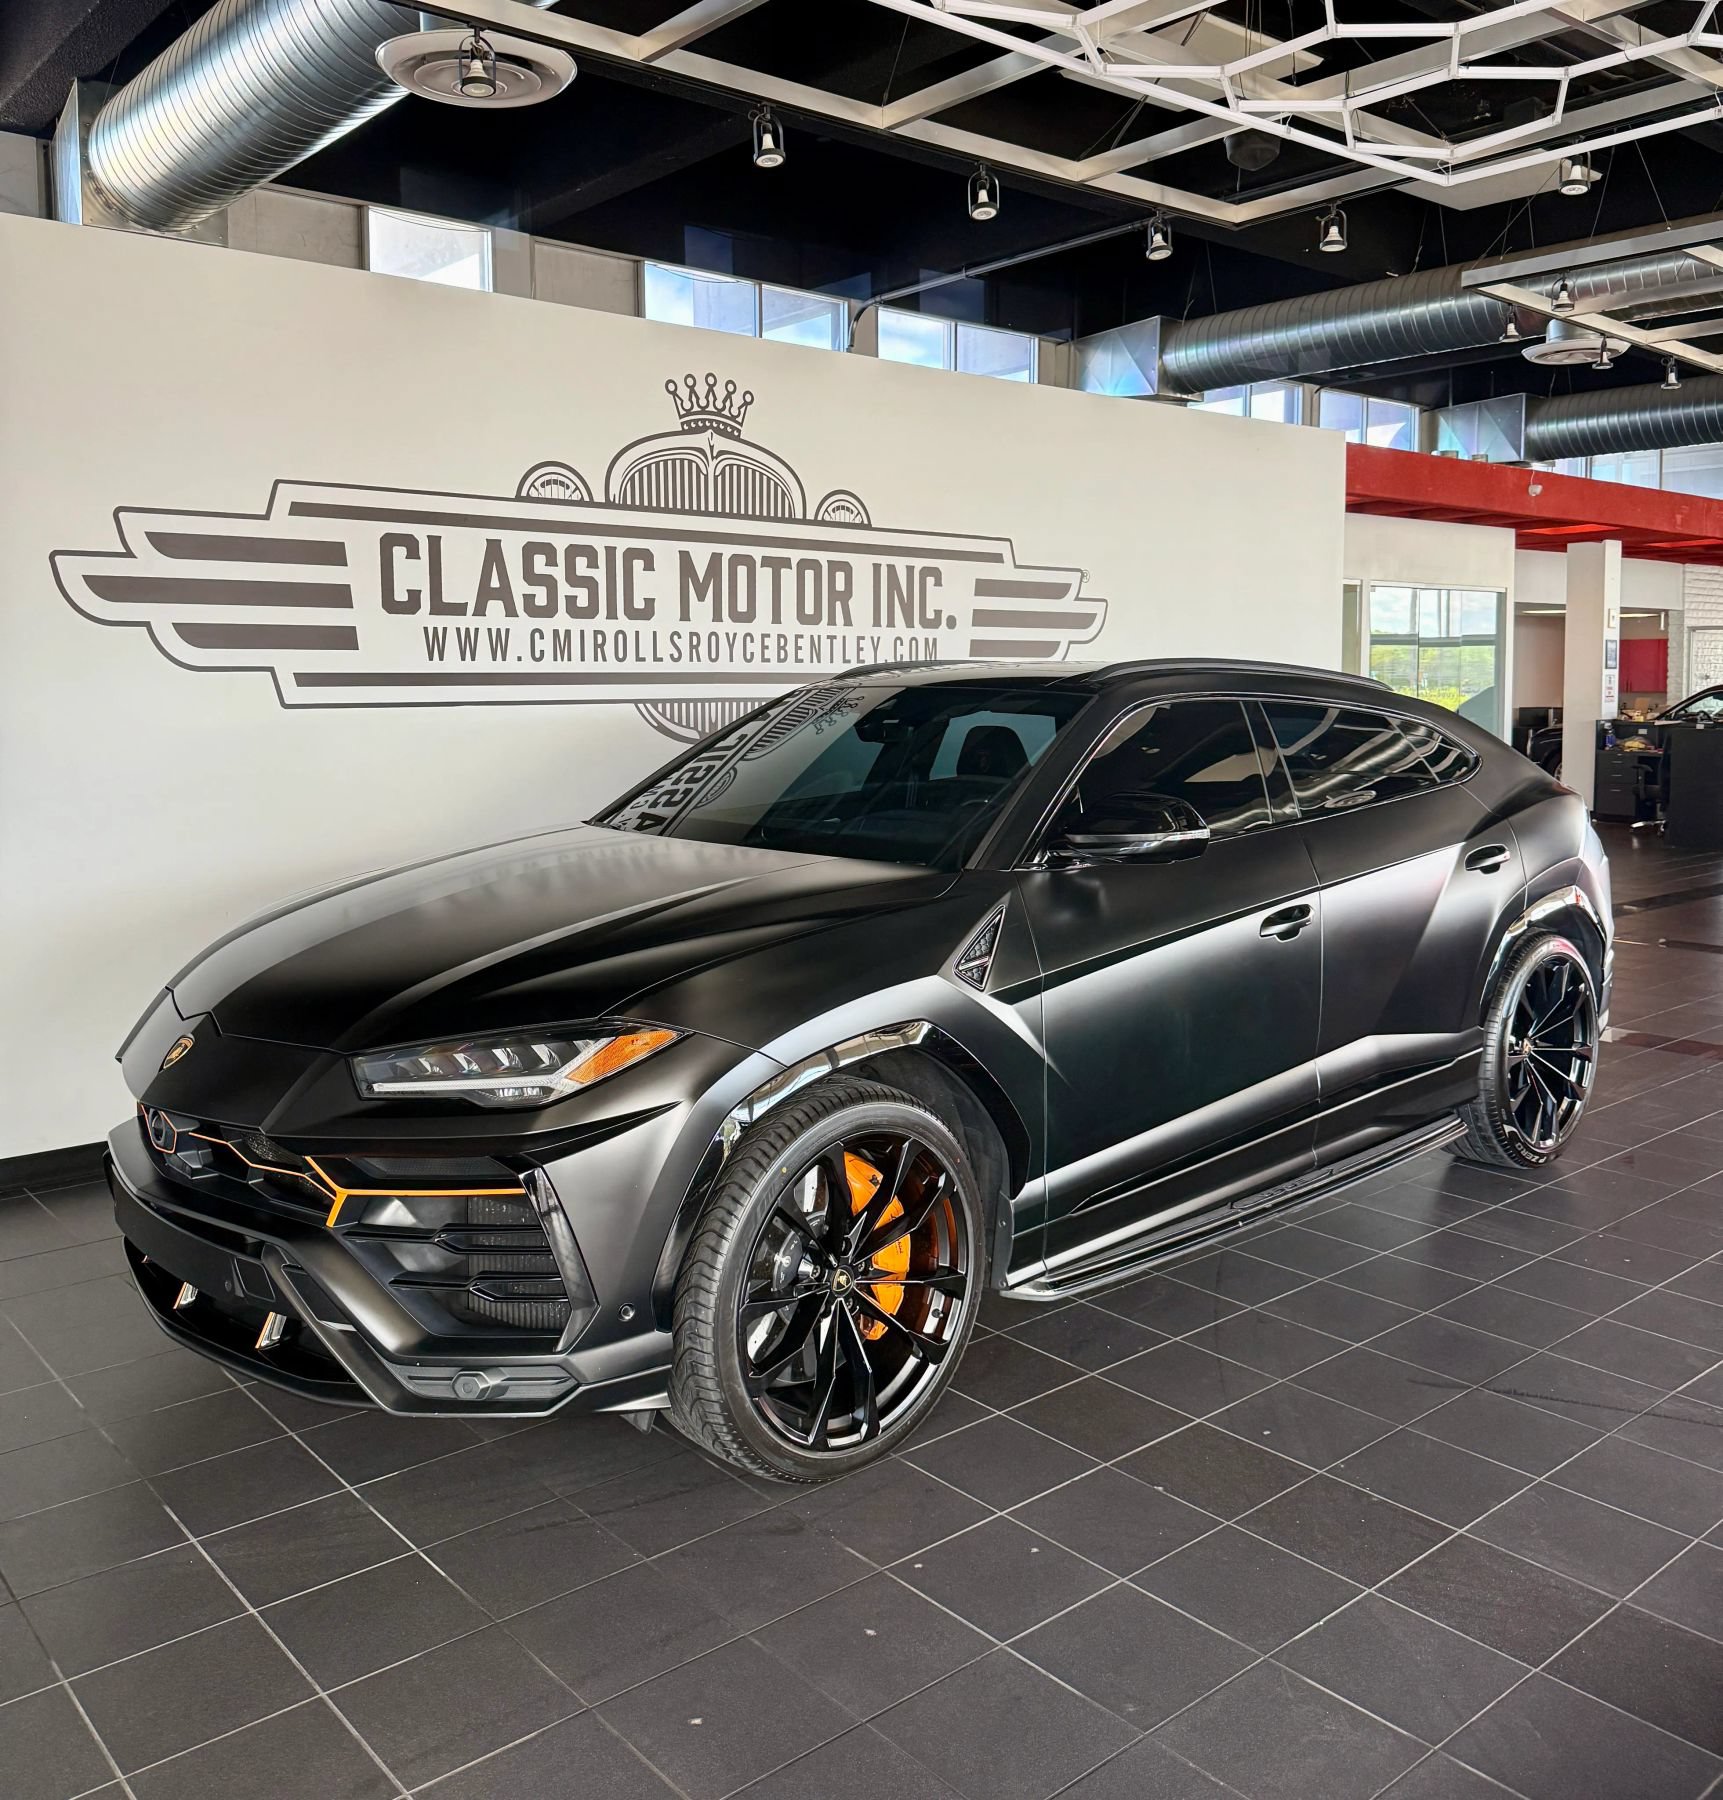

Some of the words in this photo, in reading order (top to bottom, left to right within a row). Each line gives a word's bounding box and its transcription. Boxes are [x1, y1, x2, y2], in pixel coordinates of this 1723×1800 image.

[380, 532, 656, 621] CLASSIC
[678, 550, 853, 627] MOTOR
[872, 562, 957, 630] INC.
[423, 626, 938, 664] WWW.CMIROLLSROYCEBENTLEY.COM
[1515, 1142, 1540, 1163] ZERO
